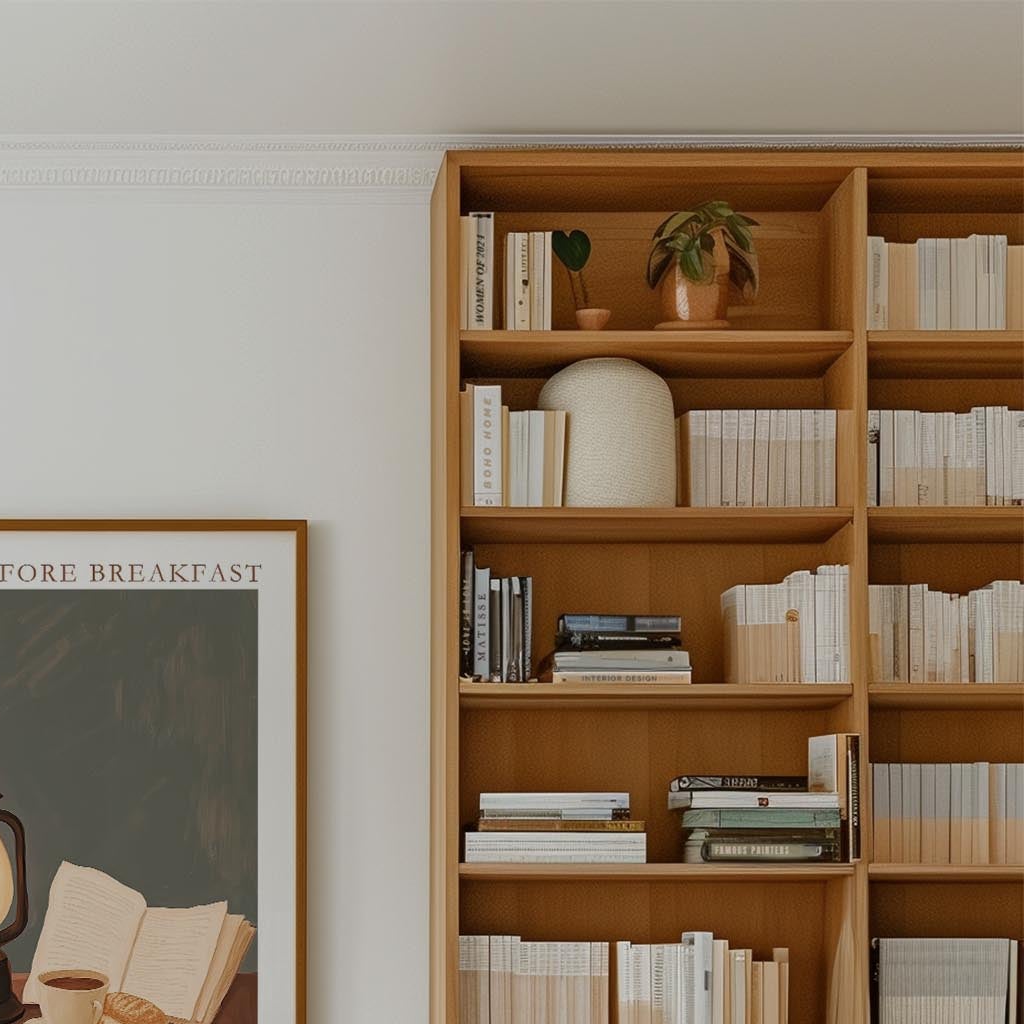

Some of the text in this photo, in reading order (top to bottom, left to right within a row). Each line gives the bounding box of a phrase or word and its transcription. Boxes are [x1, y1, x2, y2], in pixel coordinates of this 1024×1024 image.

[475, 234, 485, 324] WOMEN OF 2024
[483, 397, 492, 489] BOHO HOME
[89, 563, 262, 583] BREAKFAST
[477, 593, 487, 661] MATISSE
[714, 845, 790, 855] FAMOUS PAINTERS
